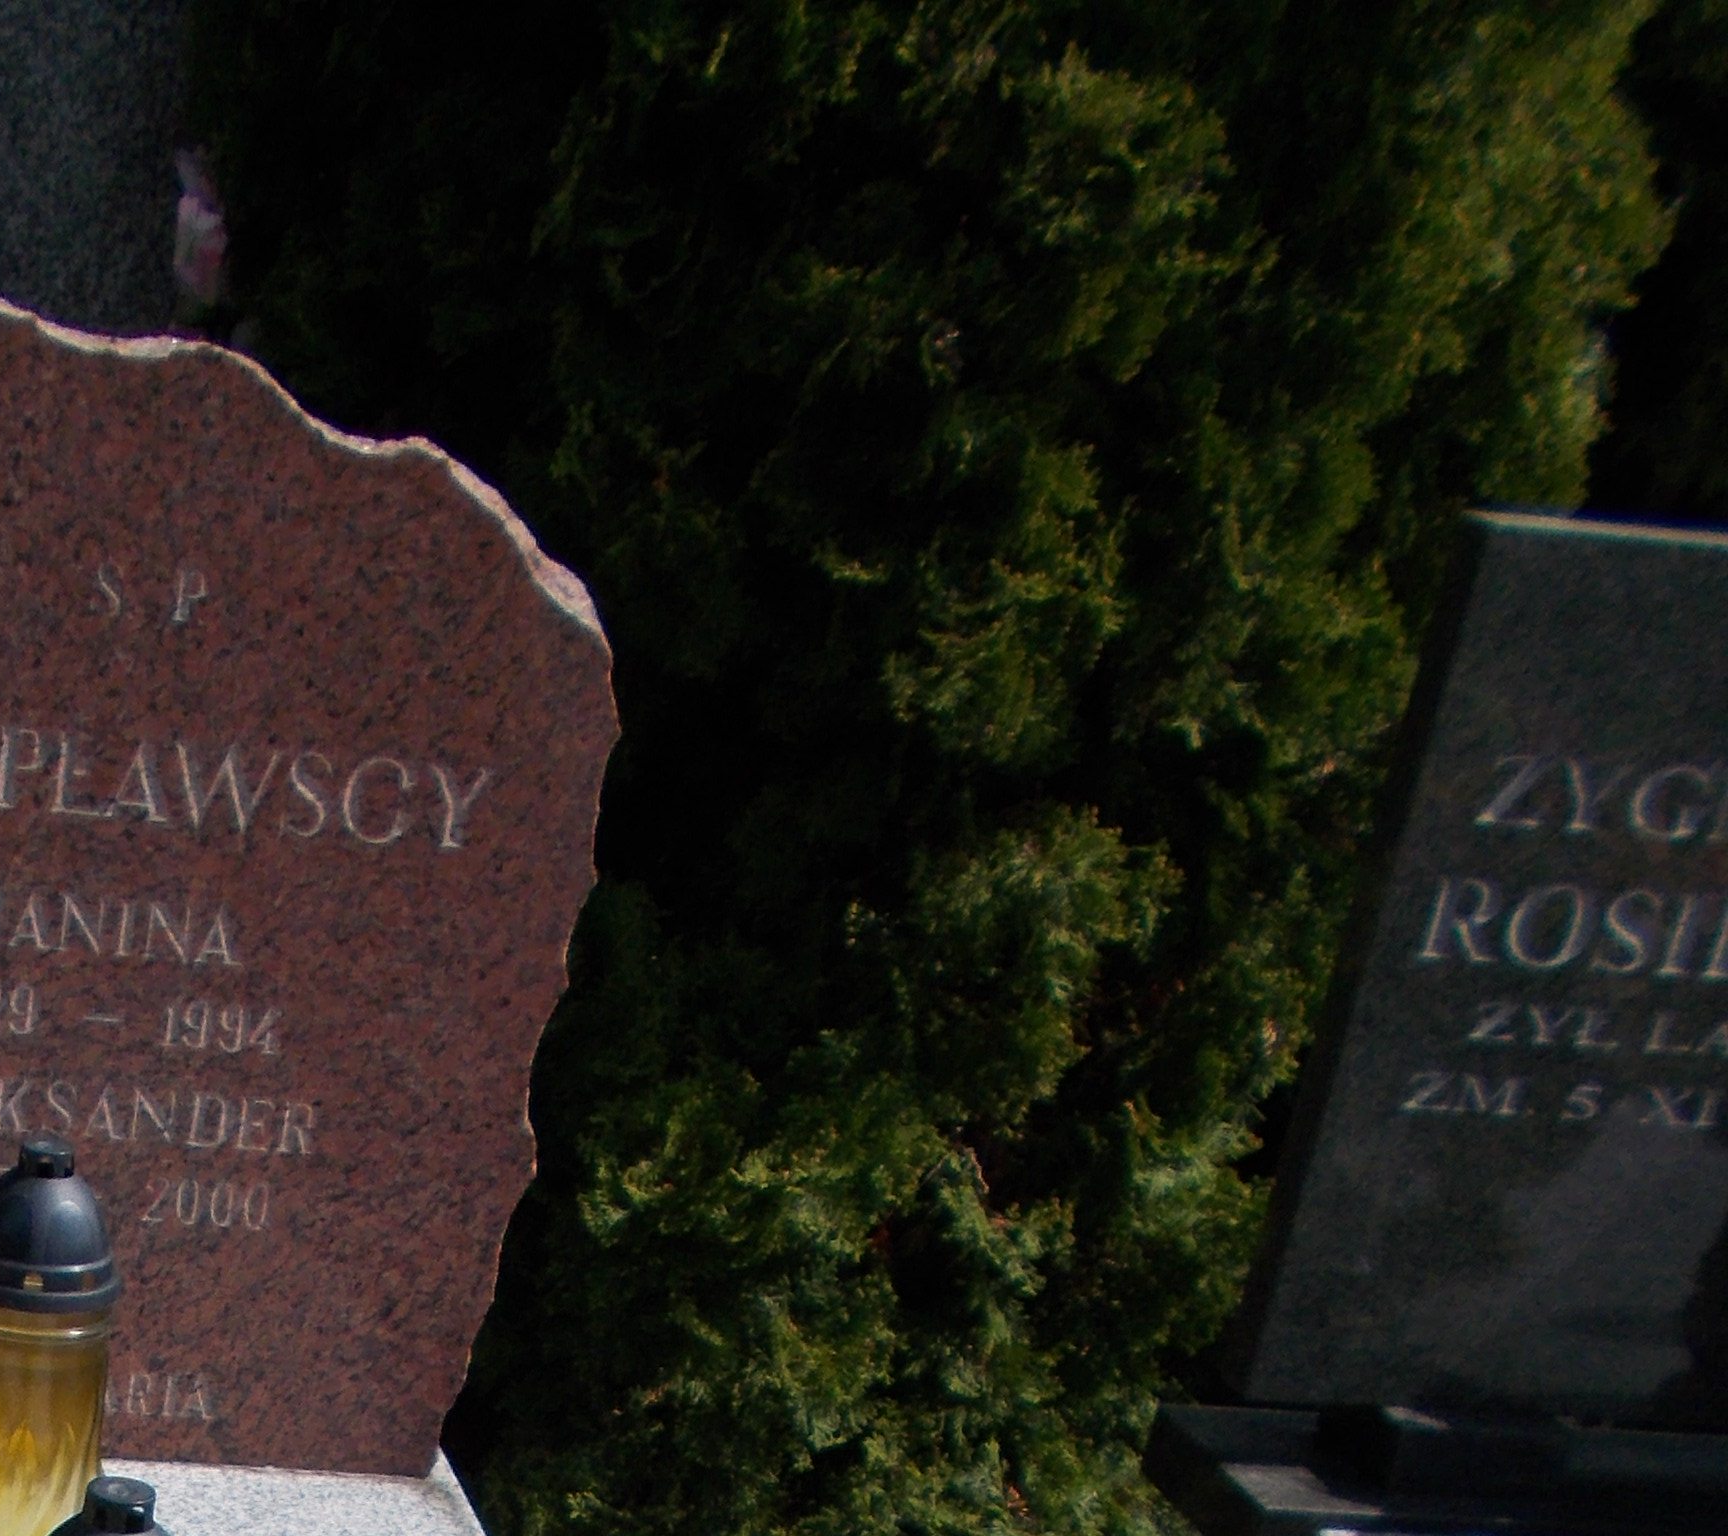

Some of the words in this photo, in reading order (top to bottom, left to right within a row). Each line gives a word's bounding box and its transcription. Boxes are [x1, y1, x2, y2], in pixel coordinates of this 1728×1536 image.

[170, 565, 209, 621] P
[159, 996, 283, 1056] 1994
[1560, 1083, 1604, 1121] 5
[140, 1177, 271, 1231] 2000
